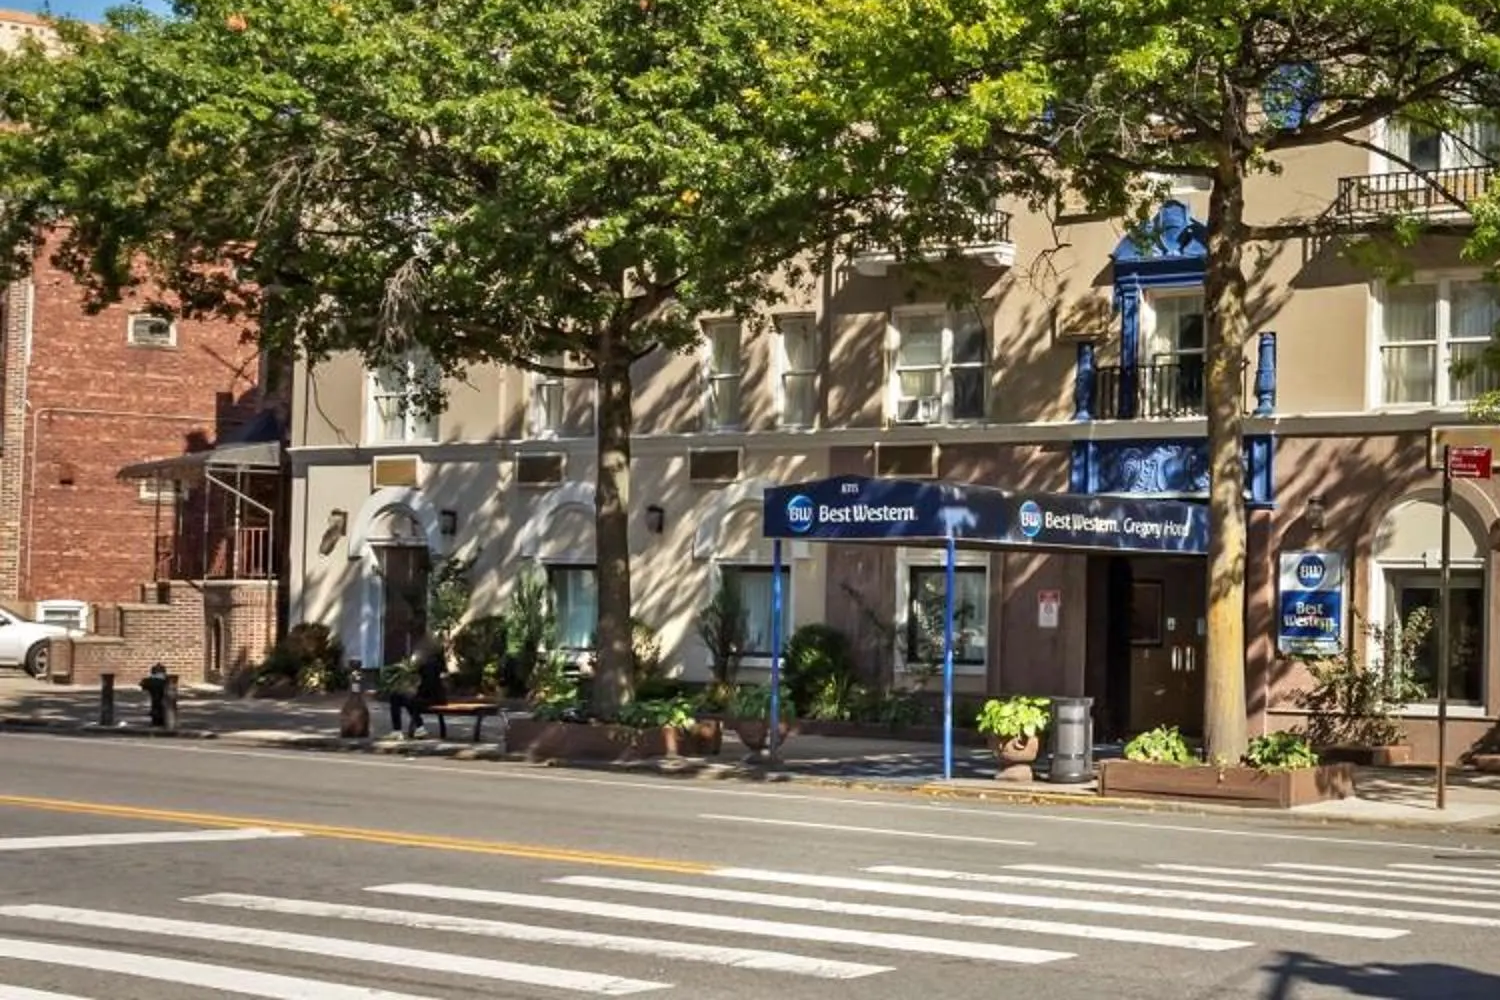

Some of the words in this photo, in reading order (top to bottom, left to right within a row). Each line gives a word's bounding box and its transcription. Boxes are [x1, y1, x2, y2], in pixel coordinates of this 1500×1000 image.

[789, 506, 812, 521] BW
[819, 505, 851, 523] Best
[1045, 511, 1071, 530] Best
[1123, 517, 1161, 539] Gregory
[1300, 565, 1323, 579] BW
[1296, 601, 1324, 615] Best
